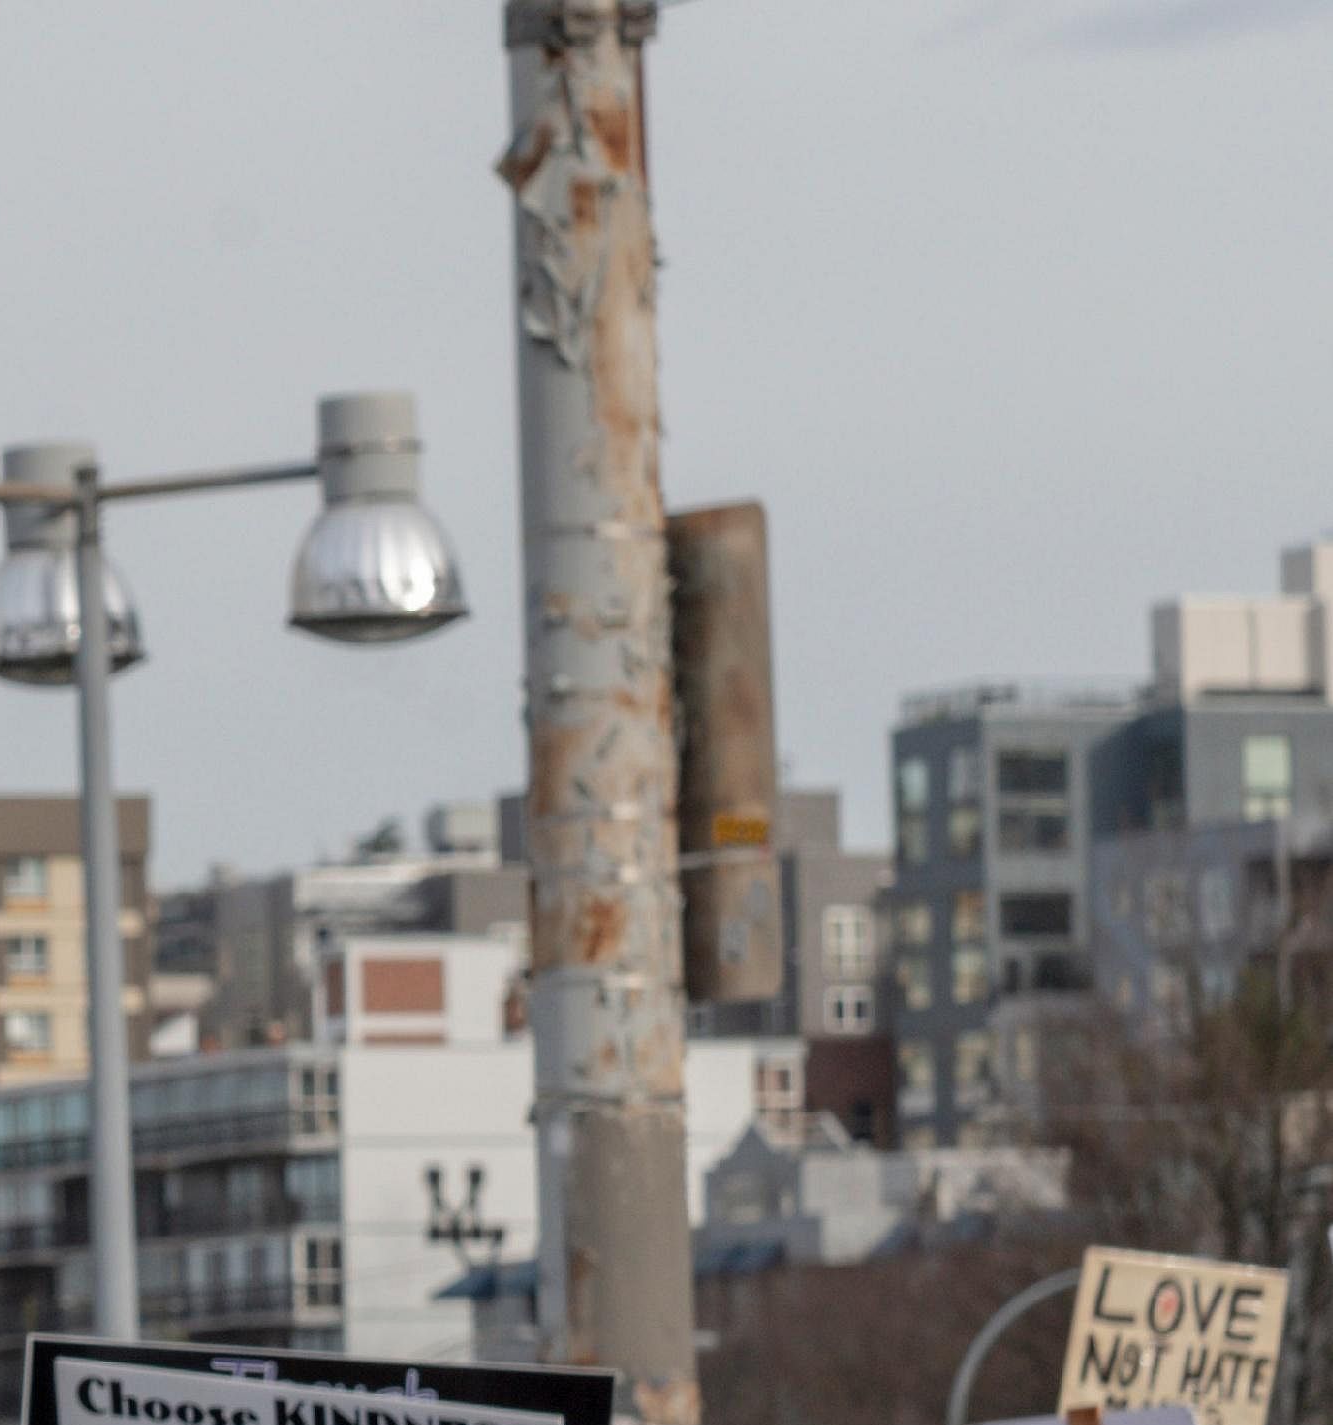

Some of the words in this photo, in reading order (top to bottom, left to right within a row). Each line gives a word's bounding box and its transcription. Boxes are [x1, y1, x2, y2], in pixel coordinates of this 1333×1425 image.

[1092, 1264, 1264, 1342] LOVE
[1080, 1335, 1171, 1388] NOT
[1179, 1346, 1270, 1400] HATE
